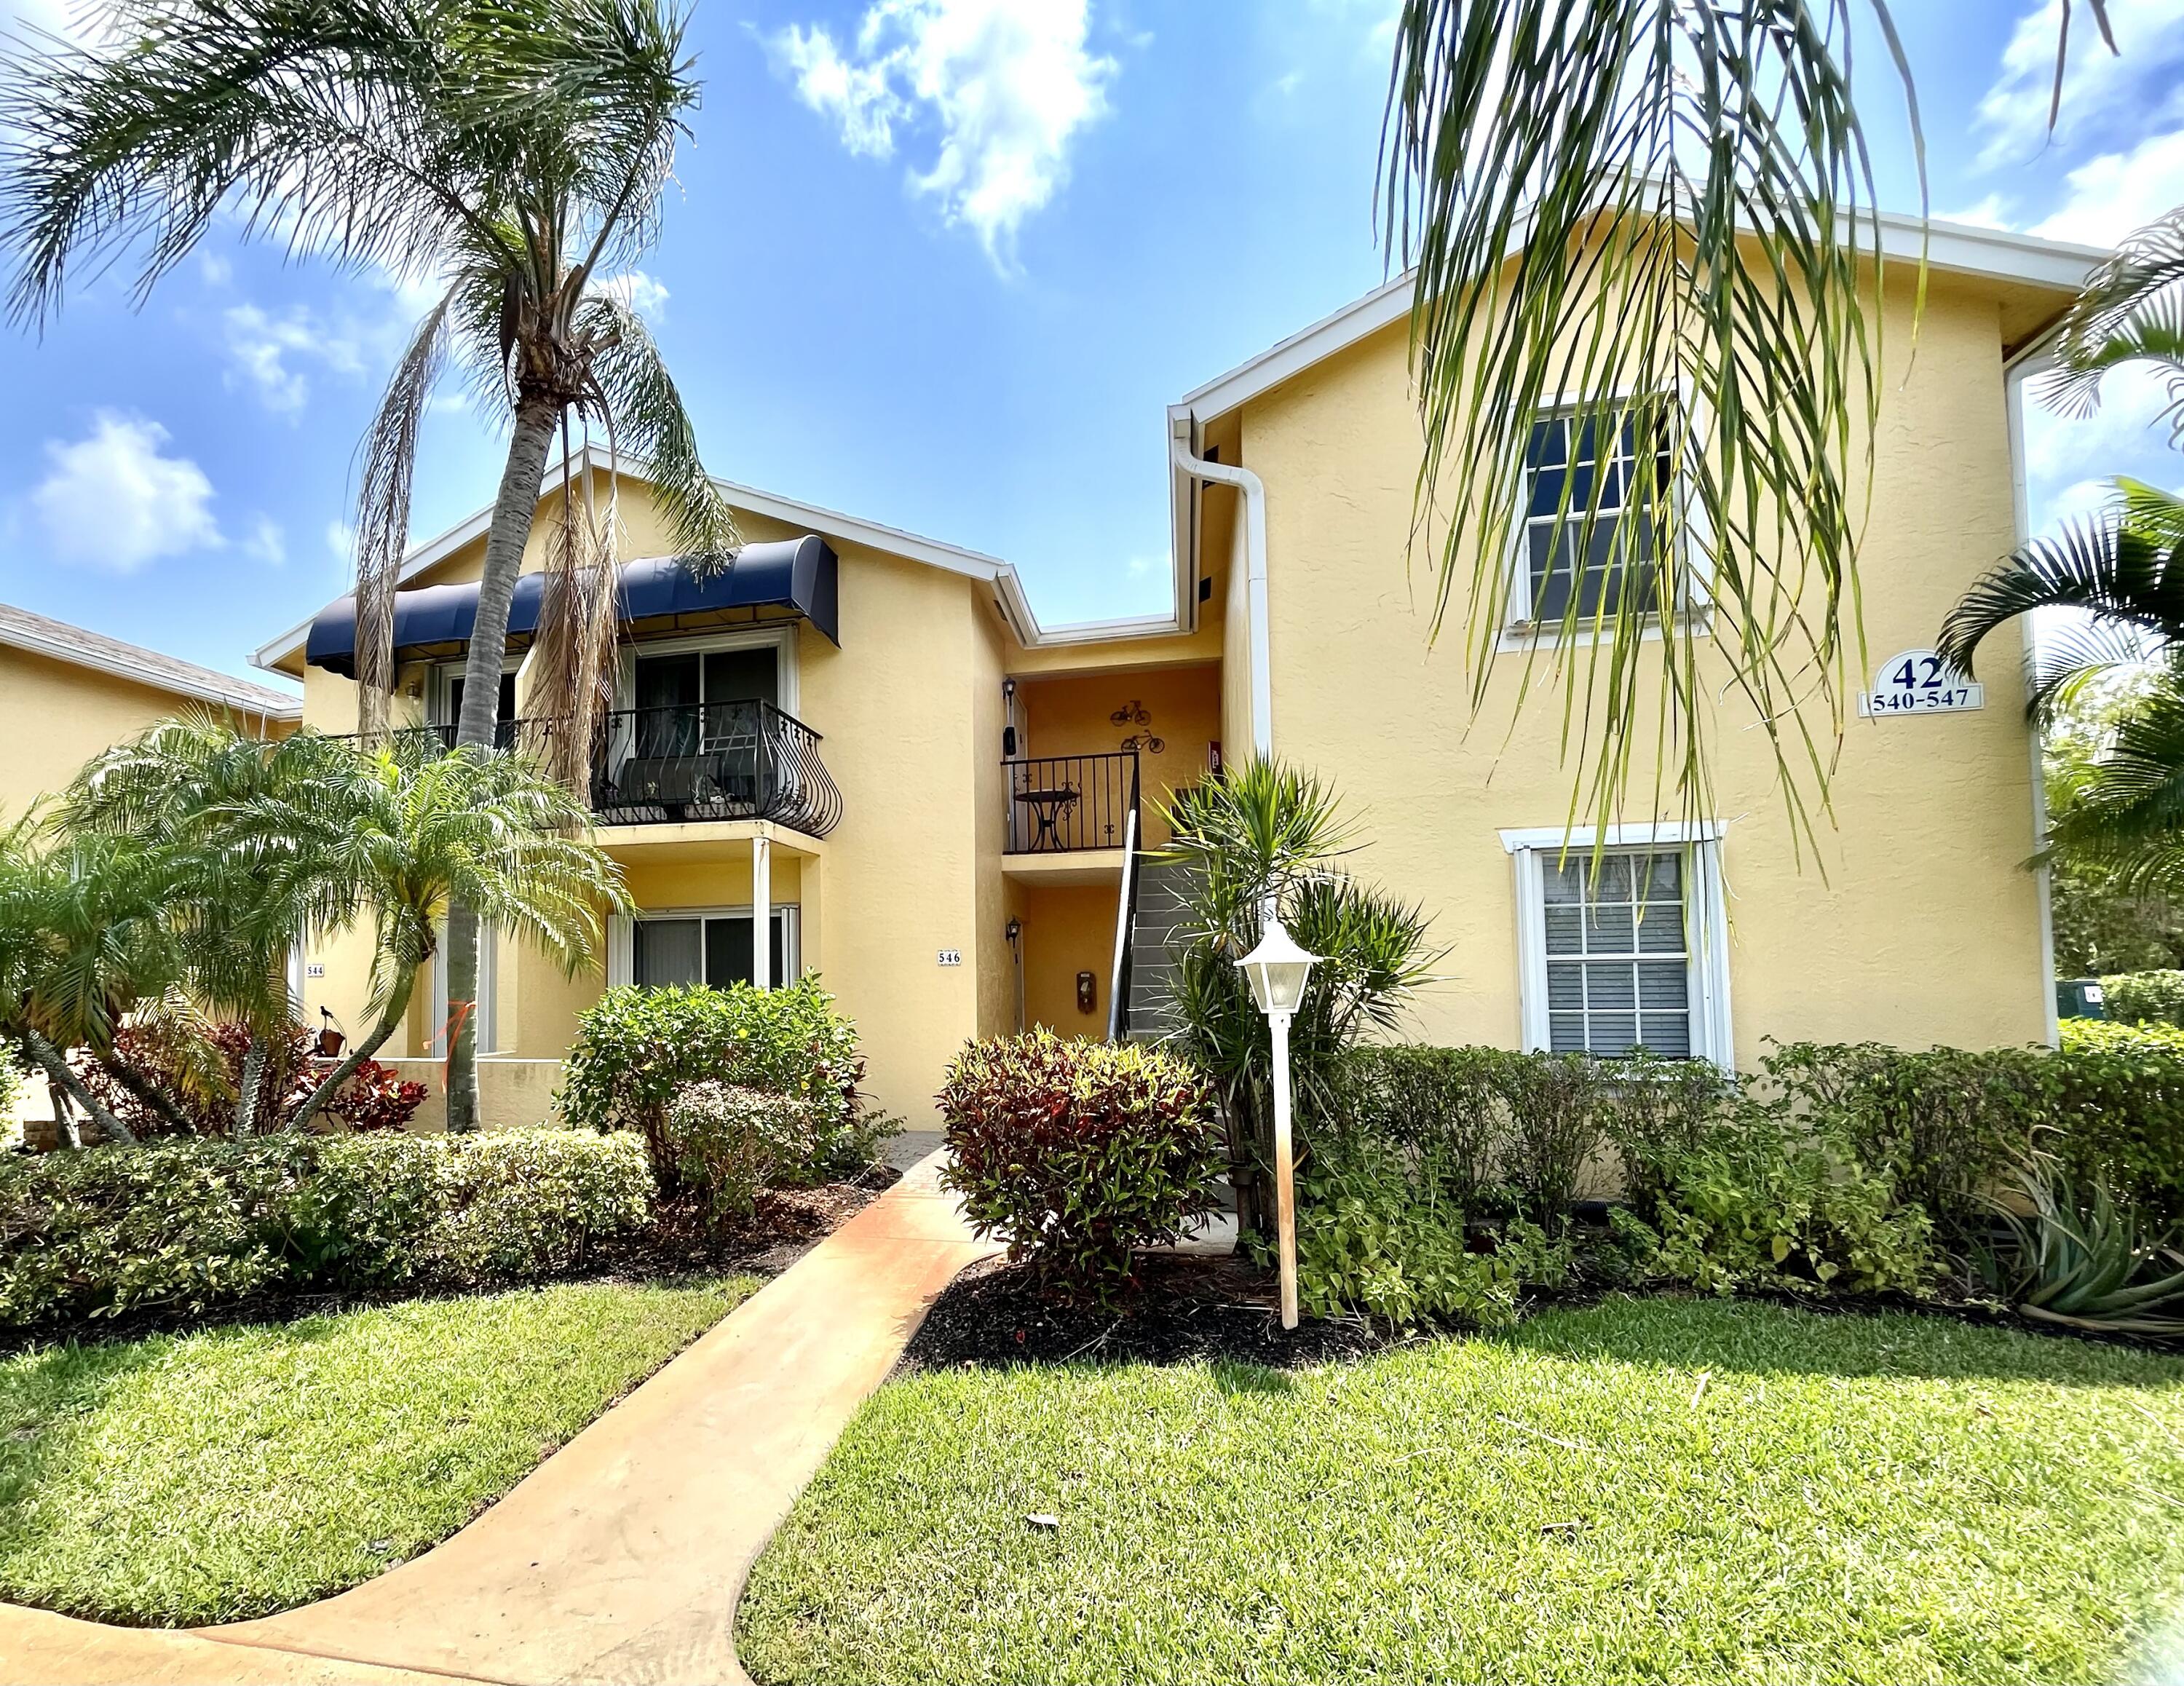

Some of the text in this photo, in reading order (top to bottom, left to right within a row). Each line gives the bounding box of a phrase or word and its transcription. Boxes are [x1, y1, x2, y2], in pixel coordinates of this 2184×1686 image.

[1893, 657, 1943, 689] 42
[1873, 689, 1969, 711] 540-547
[939, 952, 960, 962] 546
[307, 967, 323, 975] 544
